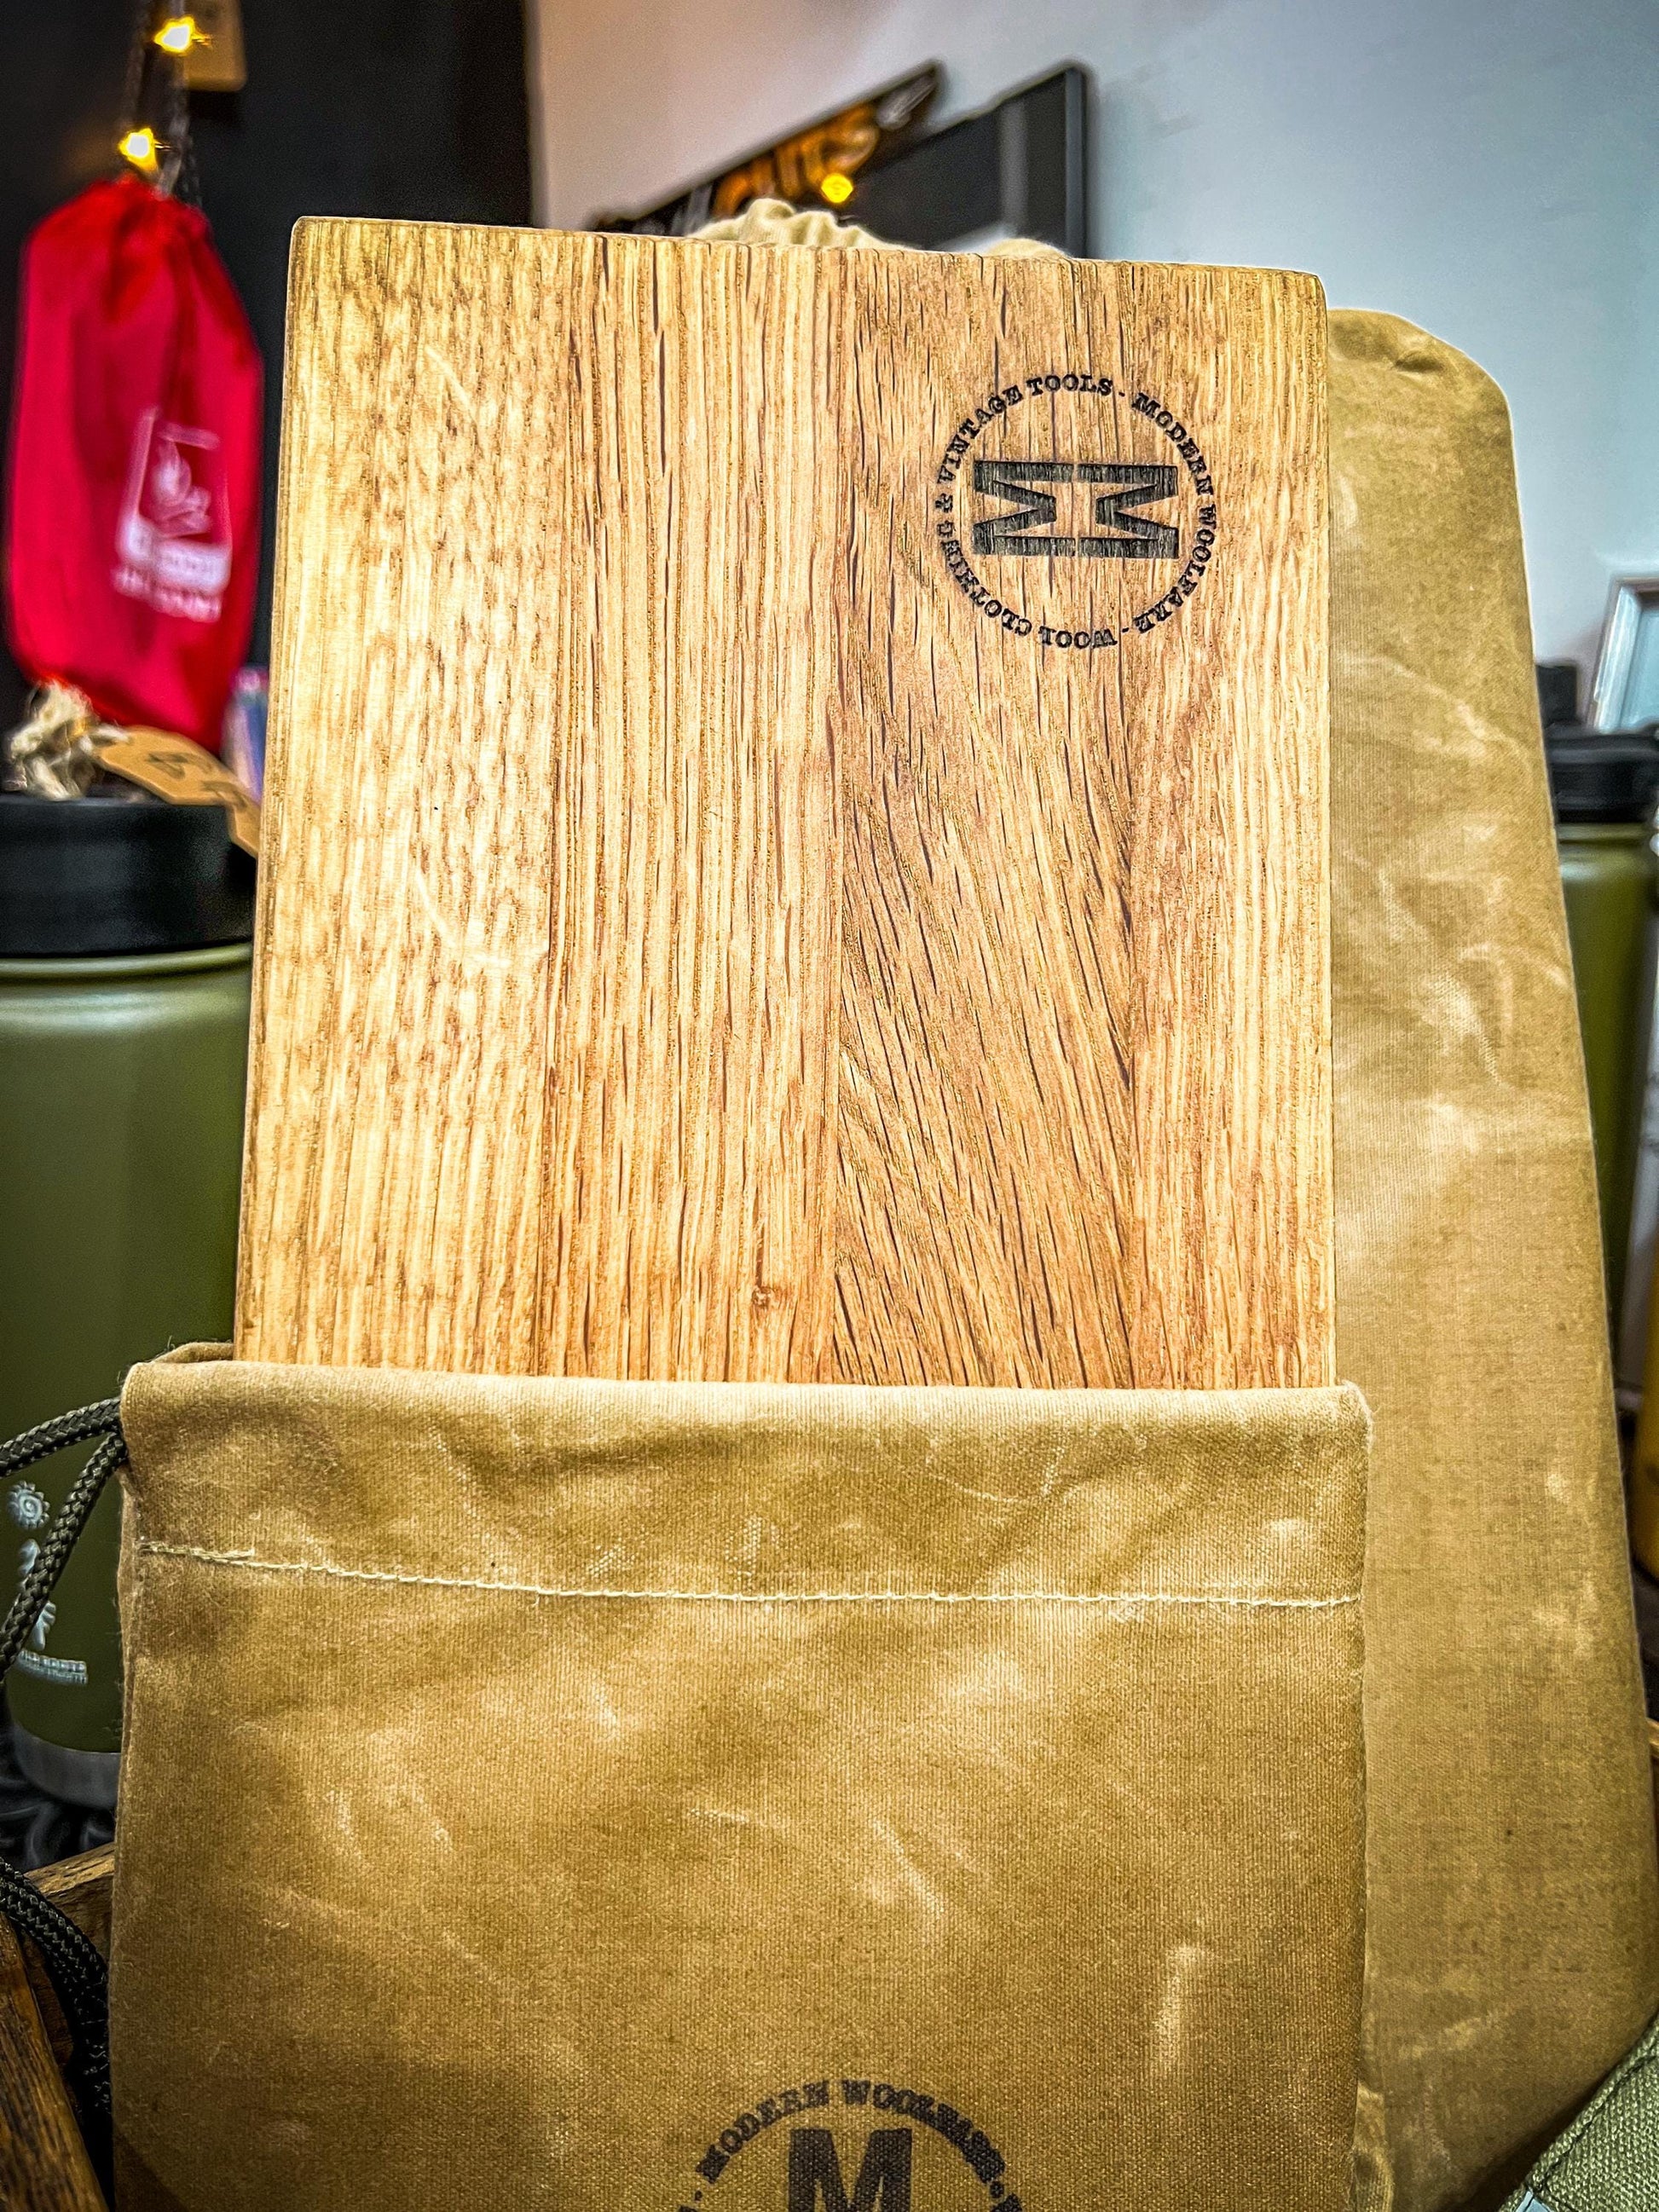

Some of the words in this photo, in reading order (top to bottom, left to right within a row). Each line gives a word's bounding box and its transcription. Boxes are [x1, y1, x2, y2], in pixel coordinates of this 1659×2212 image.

[1026, 373, 1113, 396] TOOLS
[938, 385, 1023, 483] VINTAGE
[1131, 393, 1213, 495] MODERN
[937, 521, 1032, 636] CLOTHING
[1039, 626, 1118, 649] WOOL
[789, 2128, 913, 2212] M
